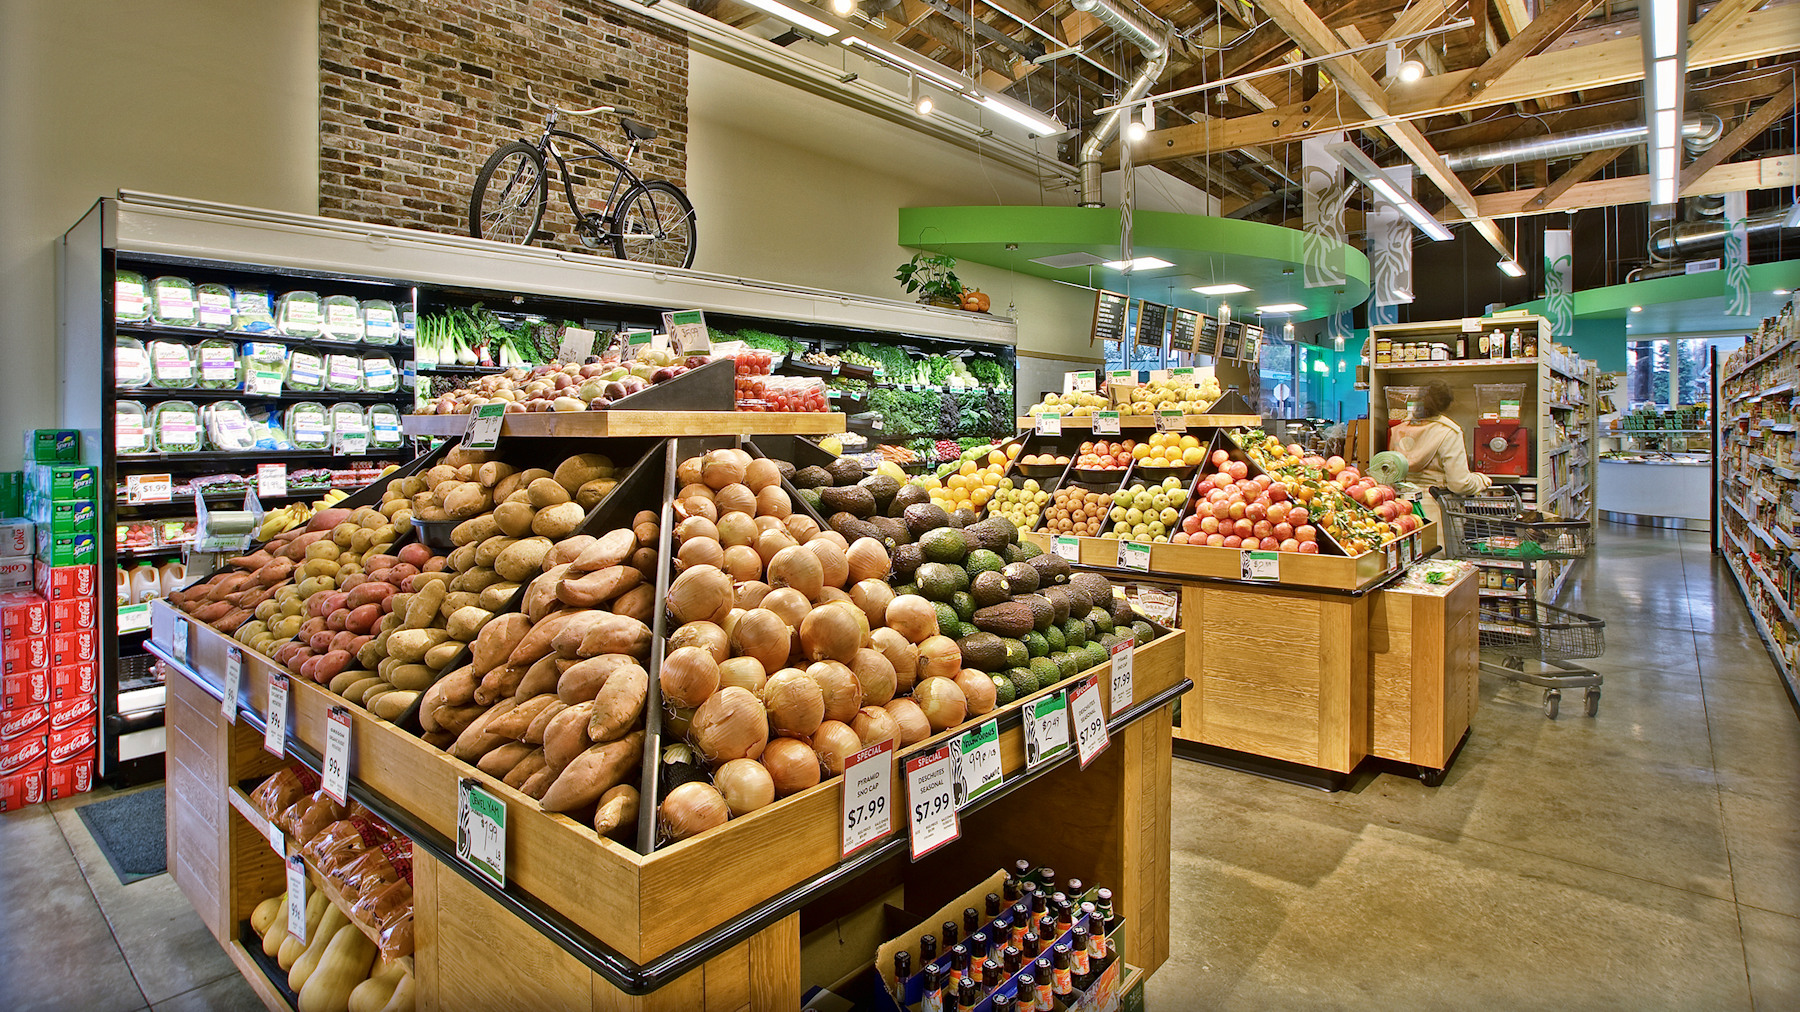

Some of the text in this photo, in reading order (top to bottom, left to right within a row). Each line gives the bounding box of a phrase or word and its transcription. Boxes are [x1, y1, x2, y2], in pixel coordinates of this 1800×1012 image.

[56, 439, 76, 451] Sprite
[73, 477, 94, 489] Sprite
[143, 484, 167, 493] $1.99
[74, 510, 95, 522] Sprite
[13, 528, 25, 551] Coke
[73, 543, 95, 555] Sprite
[0, 563, 27, 574] Coke
[1113, 671, 1131, 691] $7.99
[1078, 700, 1096, 717] DESCHUTES
[1080, 709, 1096, 723] SEASONAL
[53, 734, 62, 742] 12
[1079, 718, 1102, 745] $7.99
[856, 745, 882, 763] SPECIAL
[917, 752, 942, 767] SPECIAL
[329, 757, 341, 777] 99¢
[857, 771, 880, 787] PYRAMID
[918, 768, 945, 784] DESCHUTES
[857, 782, 879, 798] SNO CAP
[920, 780, 944, 794] SEASONAL
[471, 792, 486, 810] JEWEL
[487, 801, 500, 818] YAM
[915, 792, 950, 824] $7.99
[848, 796, 885, 831] $7.99
